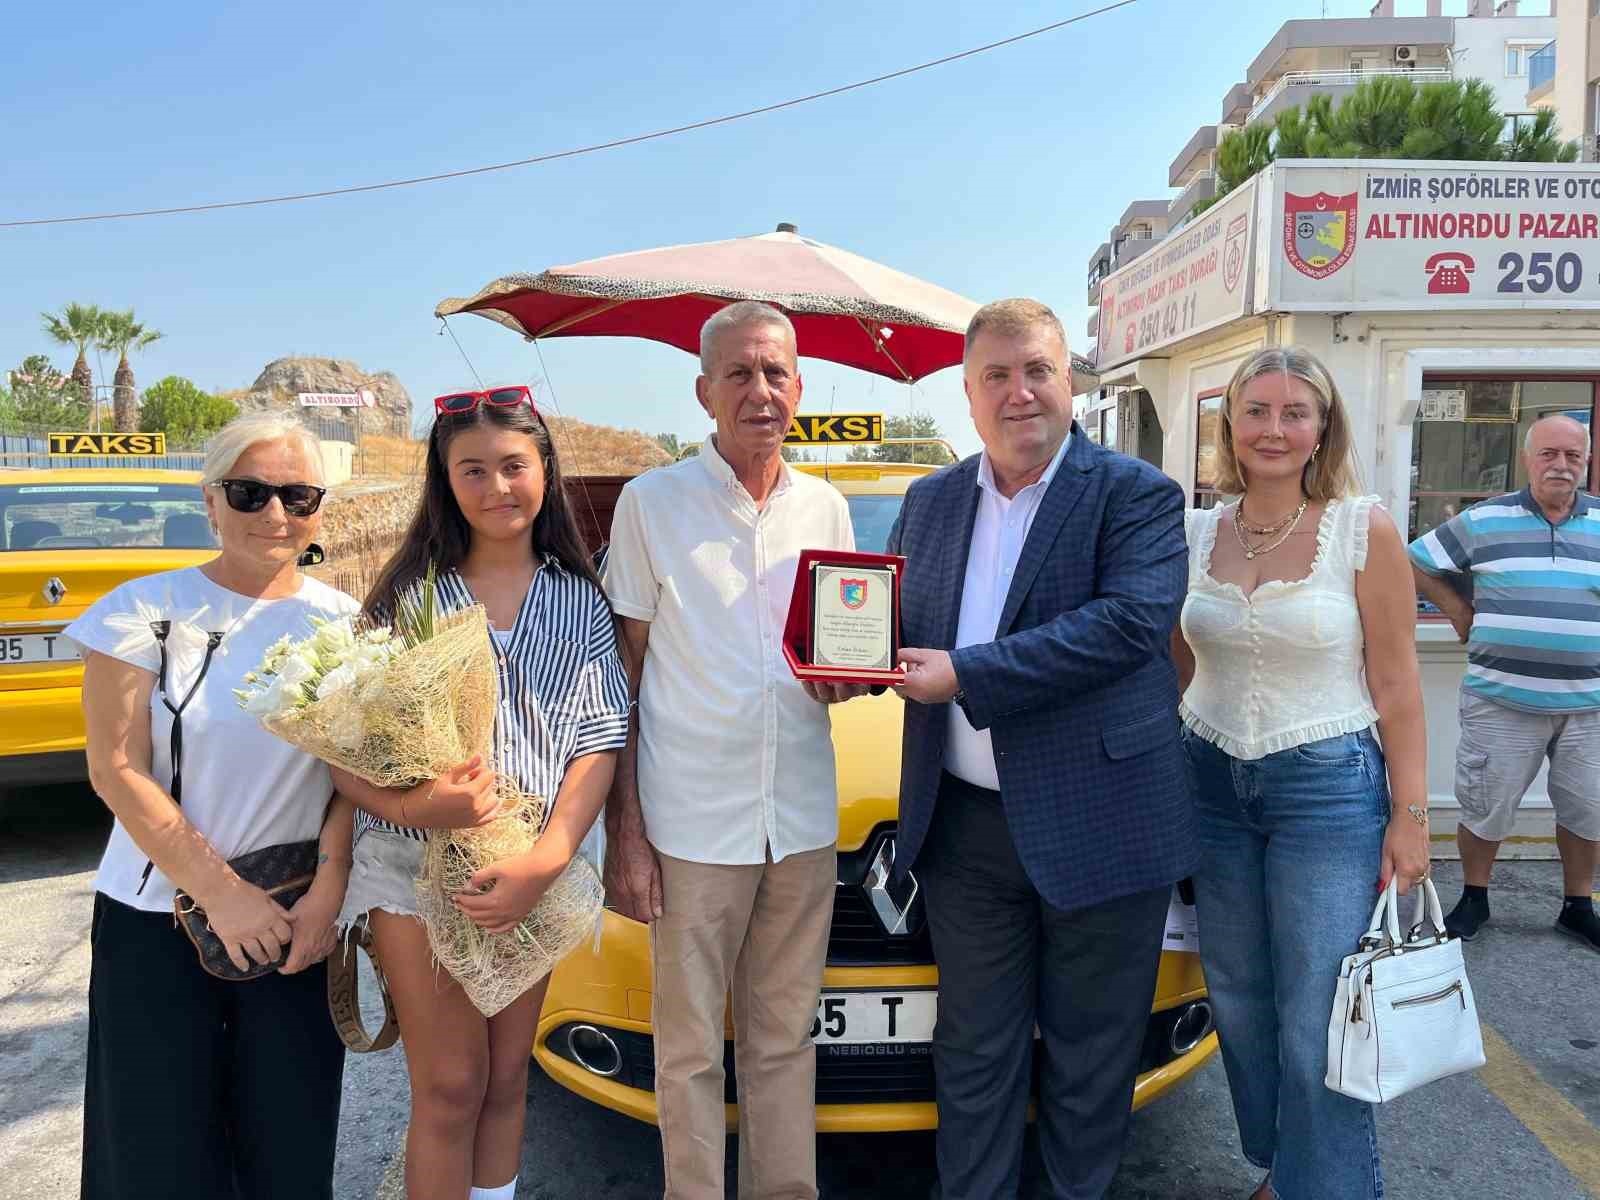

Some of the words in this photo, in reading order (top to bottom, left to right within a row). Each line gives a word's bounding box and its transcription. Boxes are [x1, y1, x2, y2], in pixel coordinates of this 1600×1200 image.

[1366, 173, 1422, 199] İZMİR
[1428, 173, 1530, 204] ŞOFÖRLER
[1535, 178, 1559, 199] VE
[1365, 213, 1511, 239] ALTINORDU
[1519, 213, 1599, 239] PAZAR
[1497, 252, 1583, 294] 250
[1139, 309, 1160, 347] 250
[785, 417, 880, 440] AKSi
[43, 636, 57, 659] T
[881, 996, 904, 1038] T
